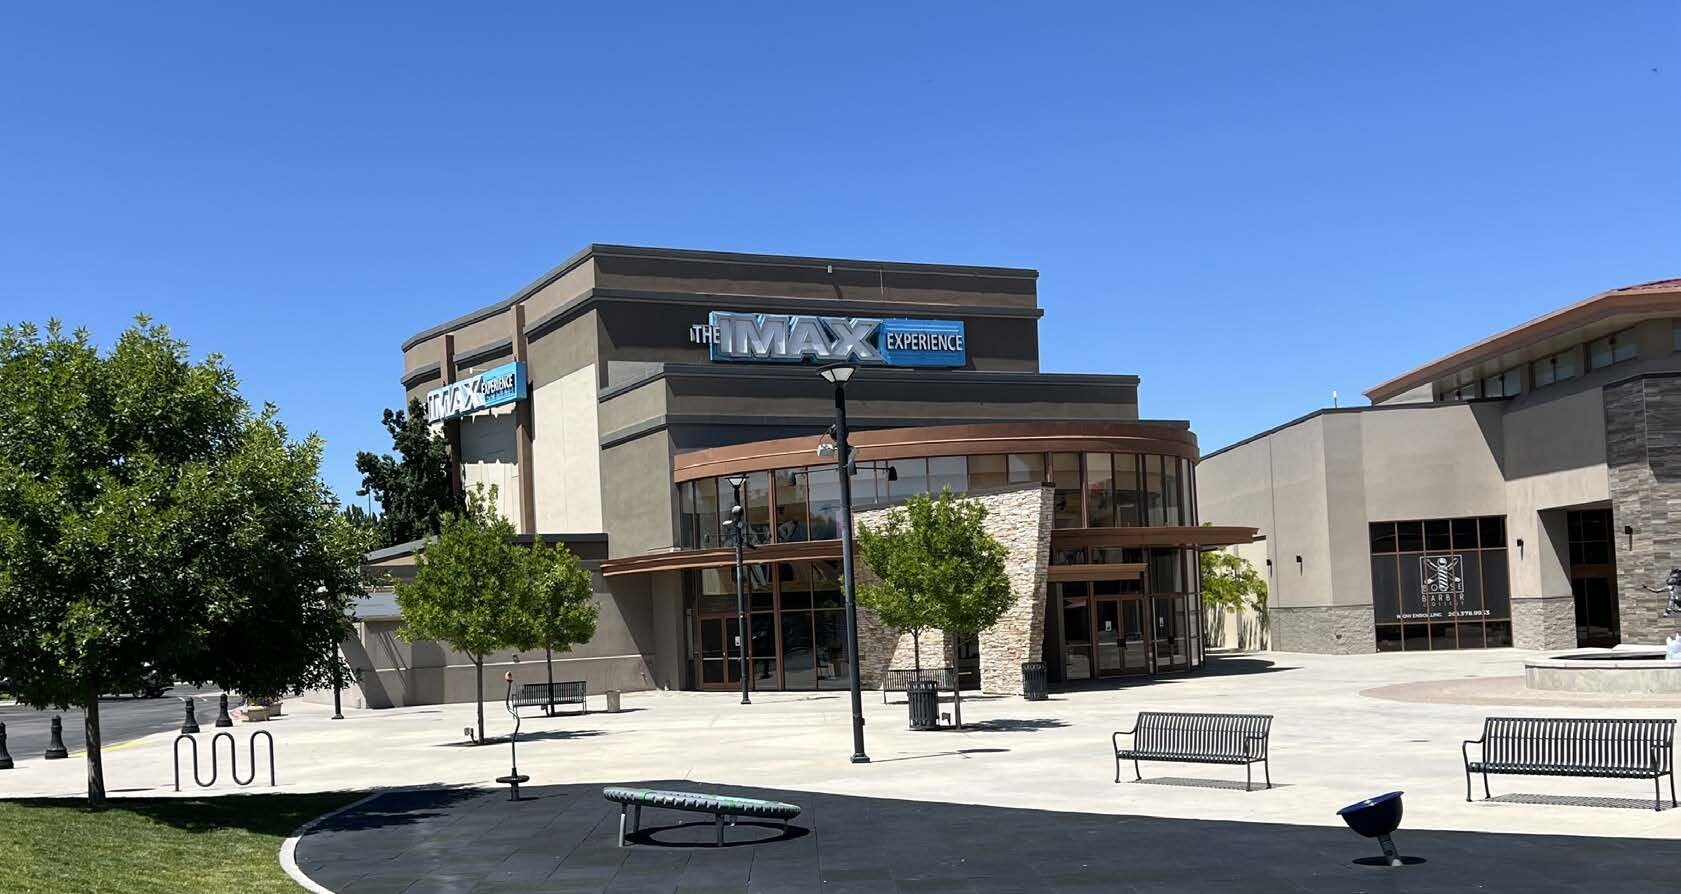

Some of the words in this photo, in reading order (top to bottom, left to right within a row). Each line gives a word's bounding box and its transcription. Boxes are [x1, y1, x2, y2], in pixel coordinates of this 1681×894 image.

[691, 324, 720, 344] THE
[717, 316, 886, 364] IMAX
[887, 332, 963, 351] EXPERIENCE
[427, 375, 485, 422] IMAX
[481, 373, 514, 395] EXPERIENCE
[1421, 593, 1465, 602] BARBR
